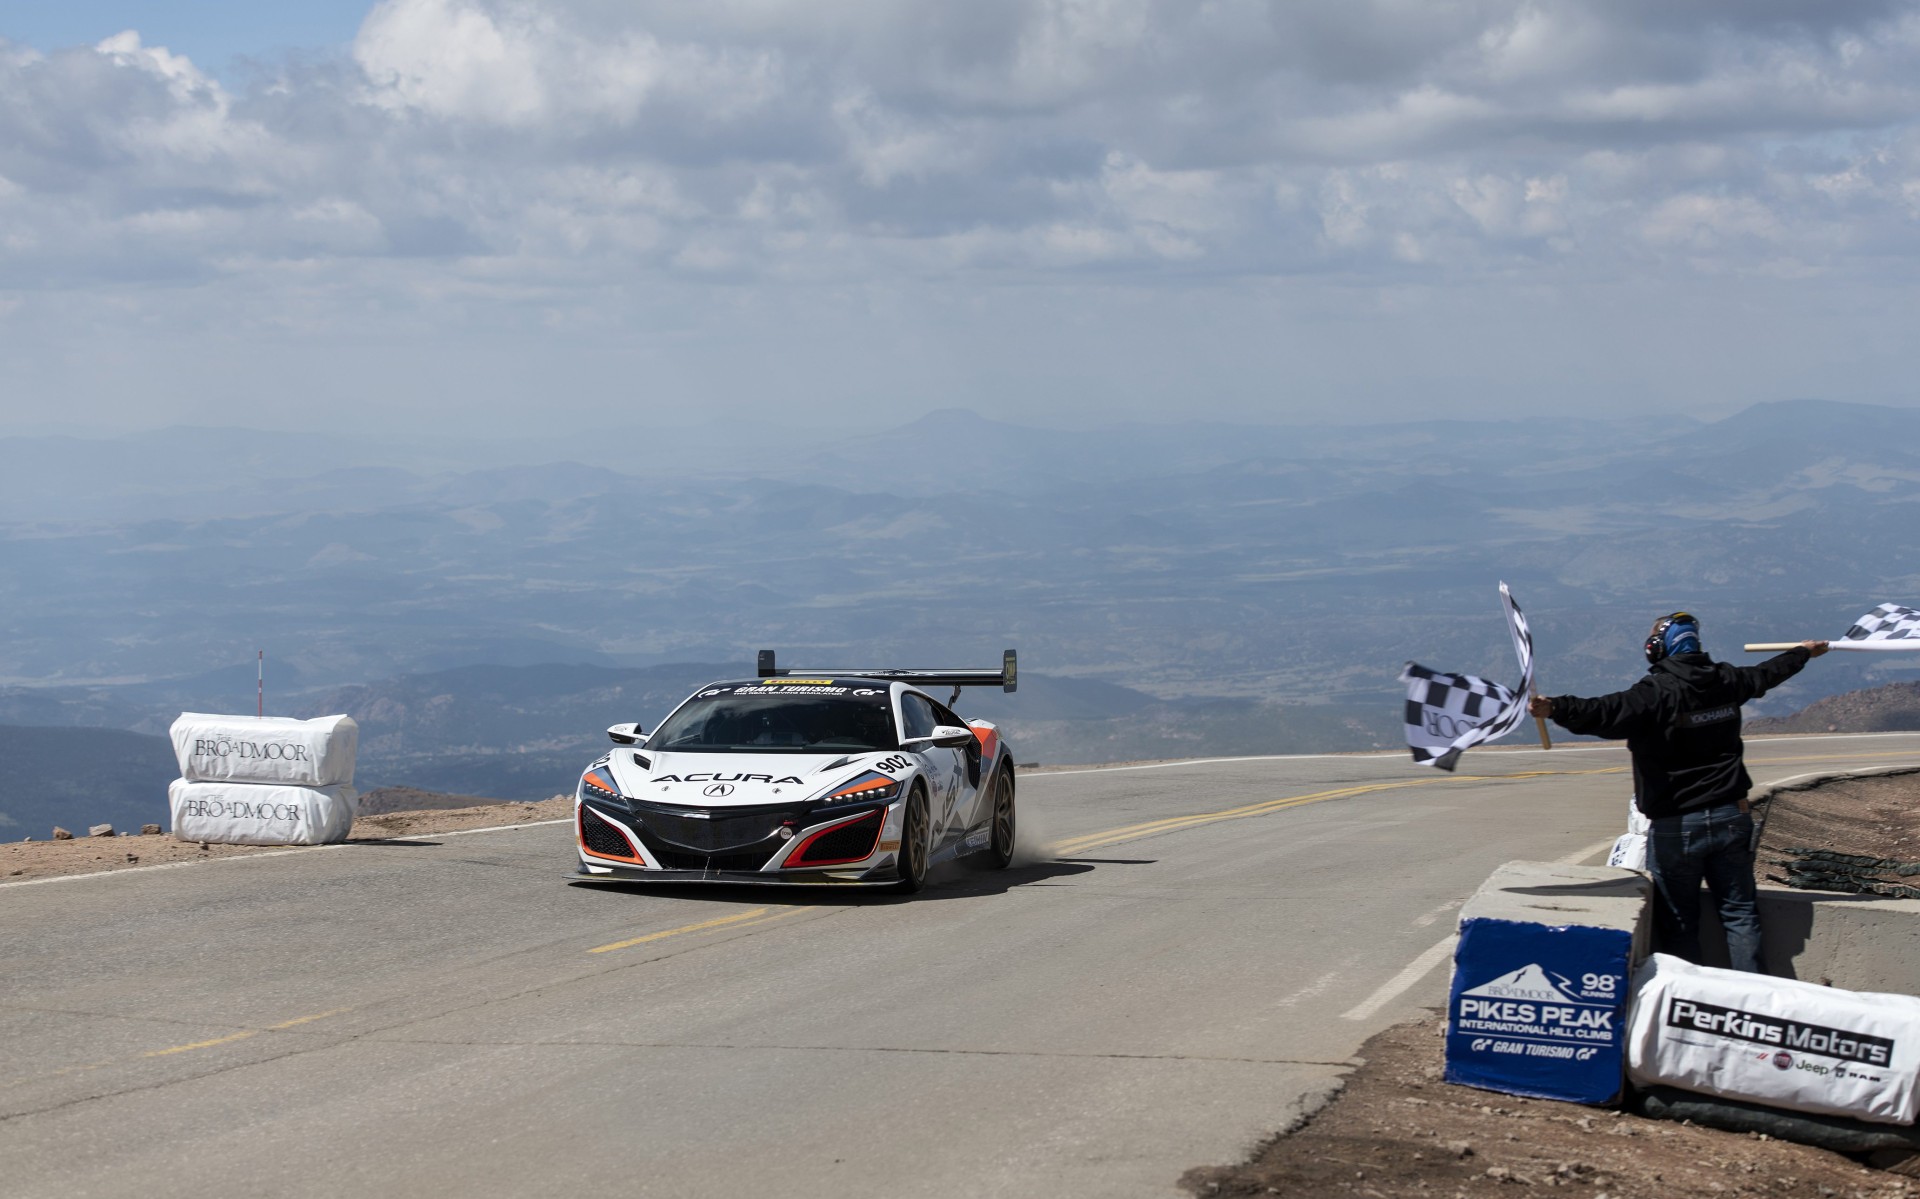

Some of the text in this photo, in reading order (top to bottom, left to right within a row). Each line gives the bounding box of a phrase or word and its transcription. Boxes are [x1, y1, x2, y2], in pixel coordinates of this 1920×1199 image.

[734, 685, 779, 693] GRAN
[779, 685, 848, 693] TURISMO
[194, 739, 309, 762] BROADMOOR
[875, 754, 914, 774] 902
[650, 772, 805, 785] ACURA
[188, 800, 301, 821] BROADMOOR
[1487, 986, 1556, 1001] BROADMOOR
[1580, 989, 1616, 999] RUNNING
[1459, 998, 1614, 1030] PIKES PEAK
[1458, 1018, 1613, 1041] INTERNATIONAL HILL CLIMB
[1671, 1001, 1889, 1064] Perkins Motors
[1492, 1040, 1524, 1055] GRAN
[1525, 1043, 1576, 1060] TURISMO
[1796, 1059, 1830, 1076] Jeep
[1848, 1071, 1881, 1083] RAM
